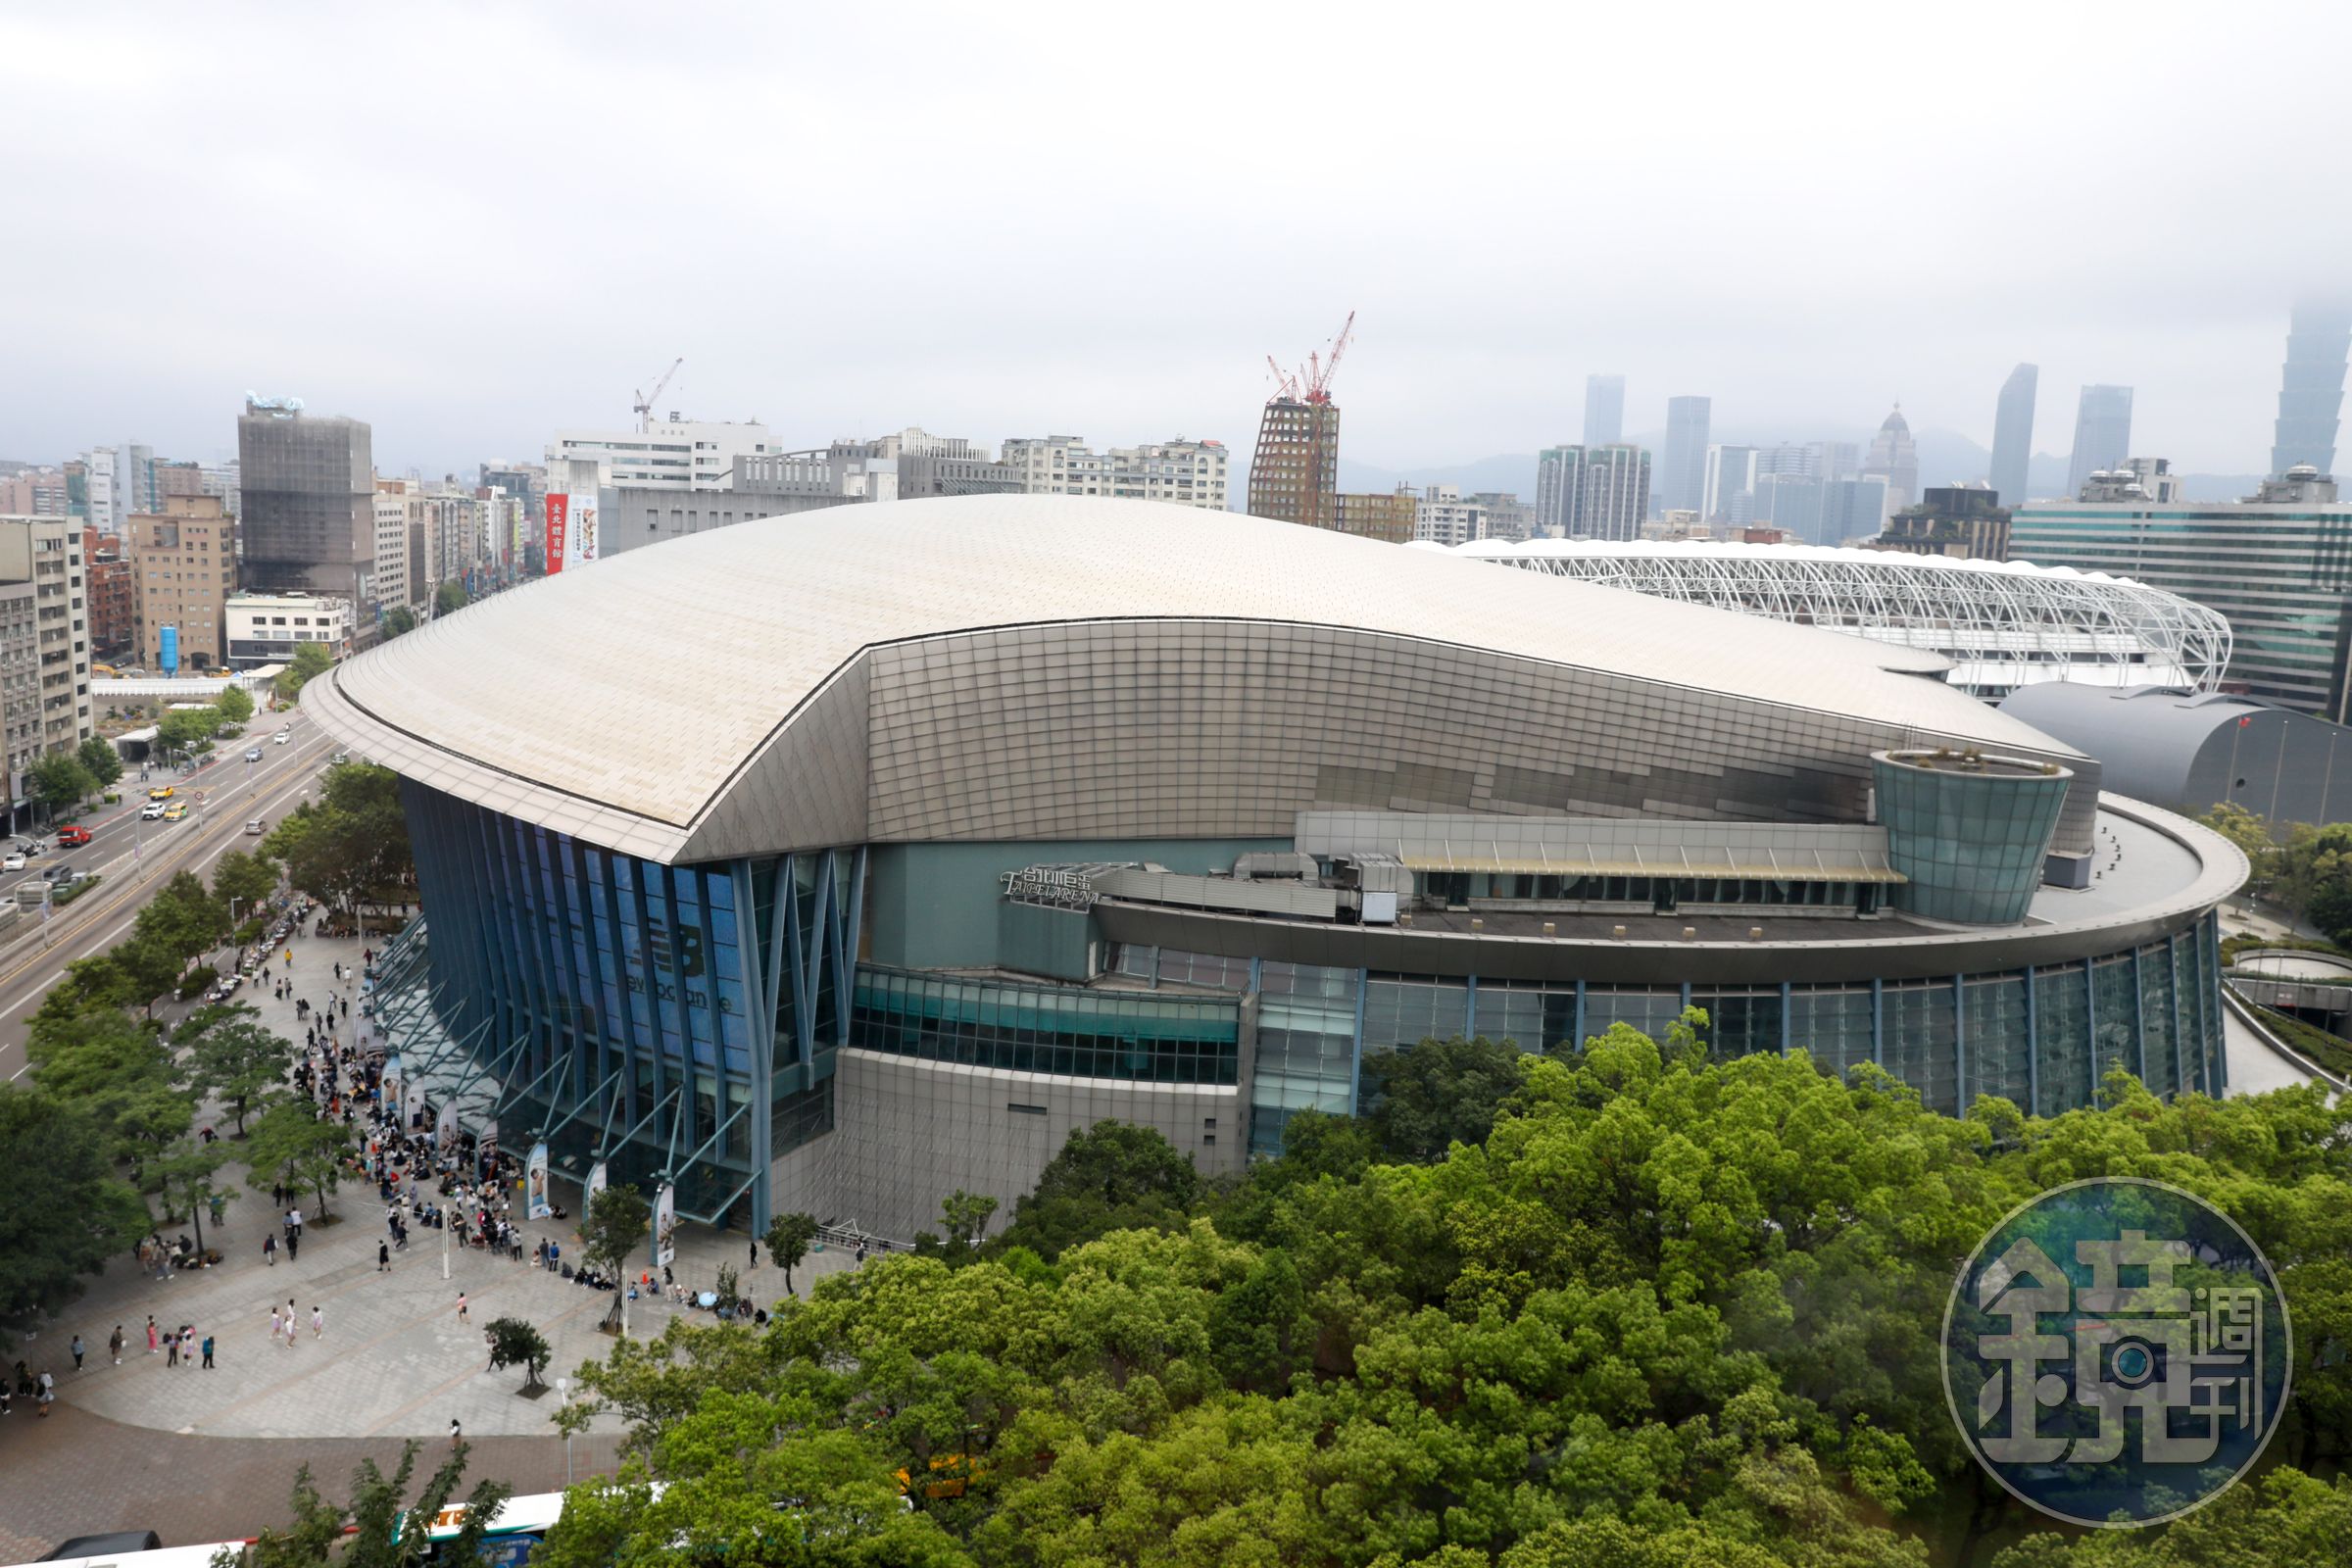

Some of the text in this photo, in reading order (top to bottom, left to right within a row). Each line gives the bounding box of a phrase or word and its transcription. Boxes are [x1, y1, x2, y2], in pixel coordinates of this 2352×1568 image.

[1001, 870, 1100, 904] TAIPEI ARENA
[1024, 866, 1091, 890] 台北小巨蛋
